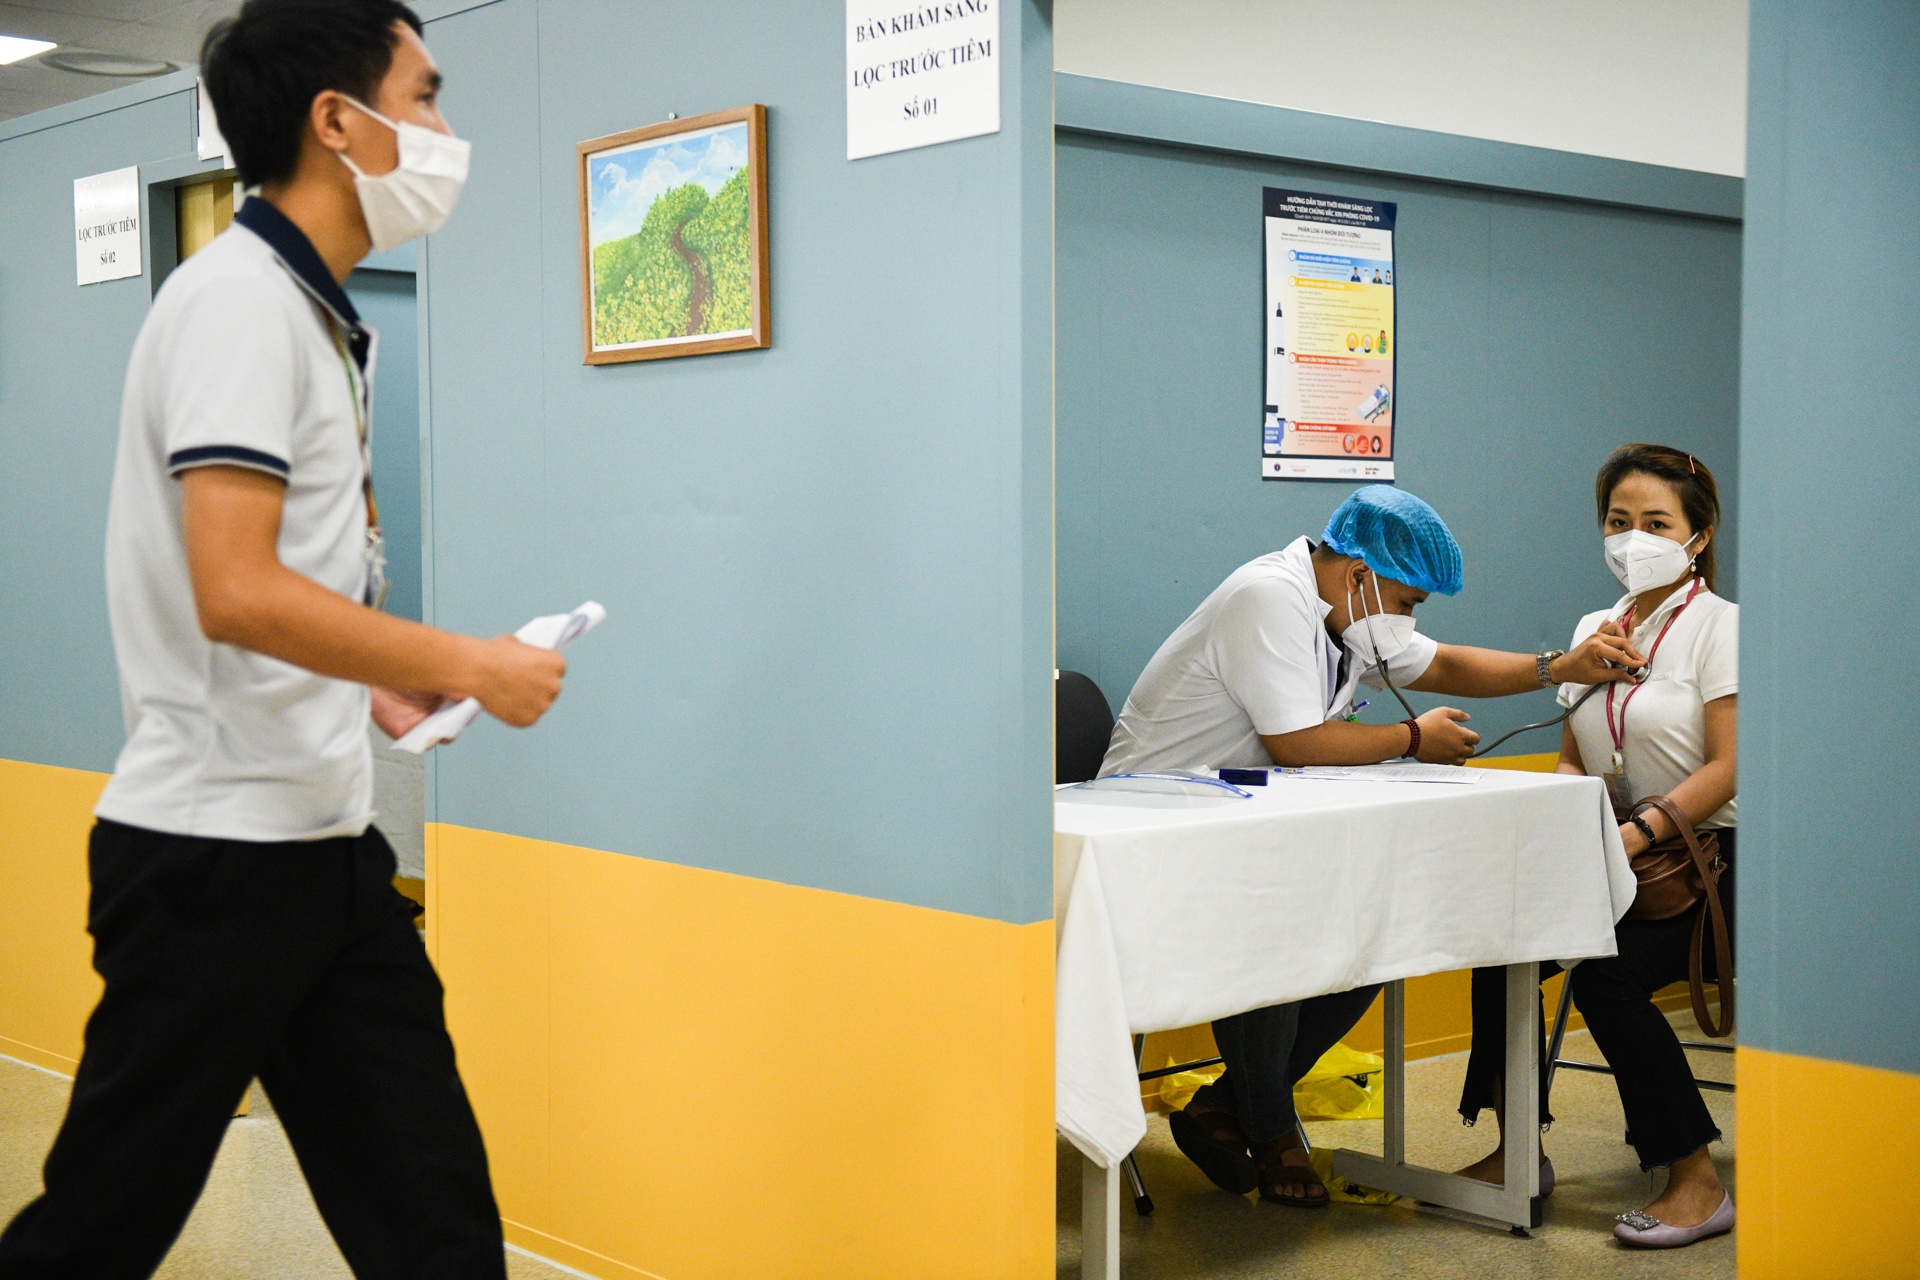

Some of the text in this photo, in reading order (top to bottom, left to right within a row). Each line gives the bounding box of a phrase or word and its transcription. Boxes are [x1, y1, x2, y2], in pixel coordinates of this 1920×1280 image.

[856, 18, 886, 42] BÀN
[892, 5, 940, 34] KHÁM
[854, 38, 992, 88] LỌC TRƯỚC TIÊM
[904, 96, 938, 120] Số 01
[78, 216, 136, 242] LỌC TRƯỚC TIÊM
[100, 250, 116, 265] Số 02
